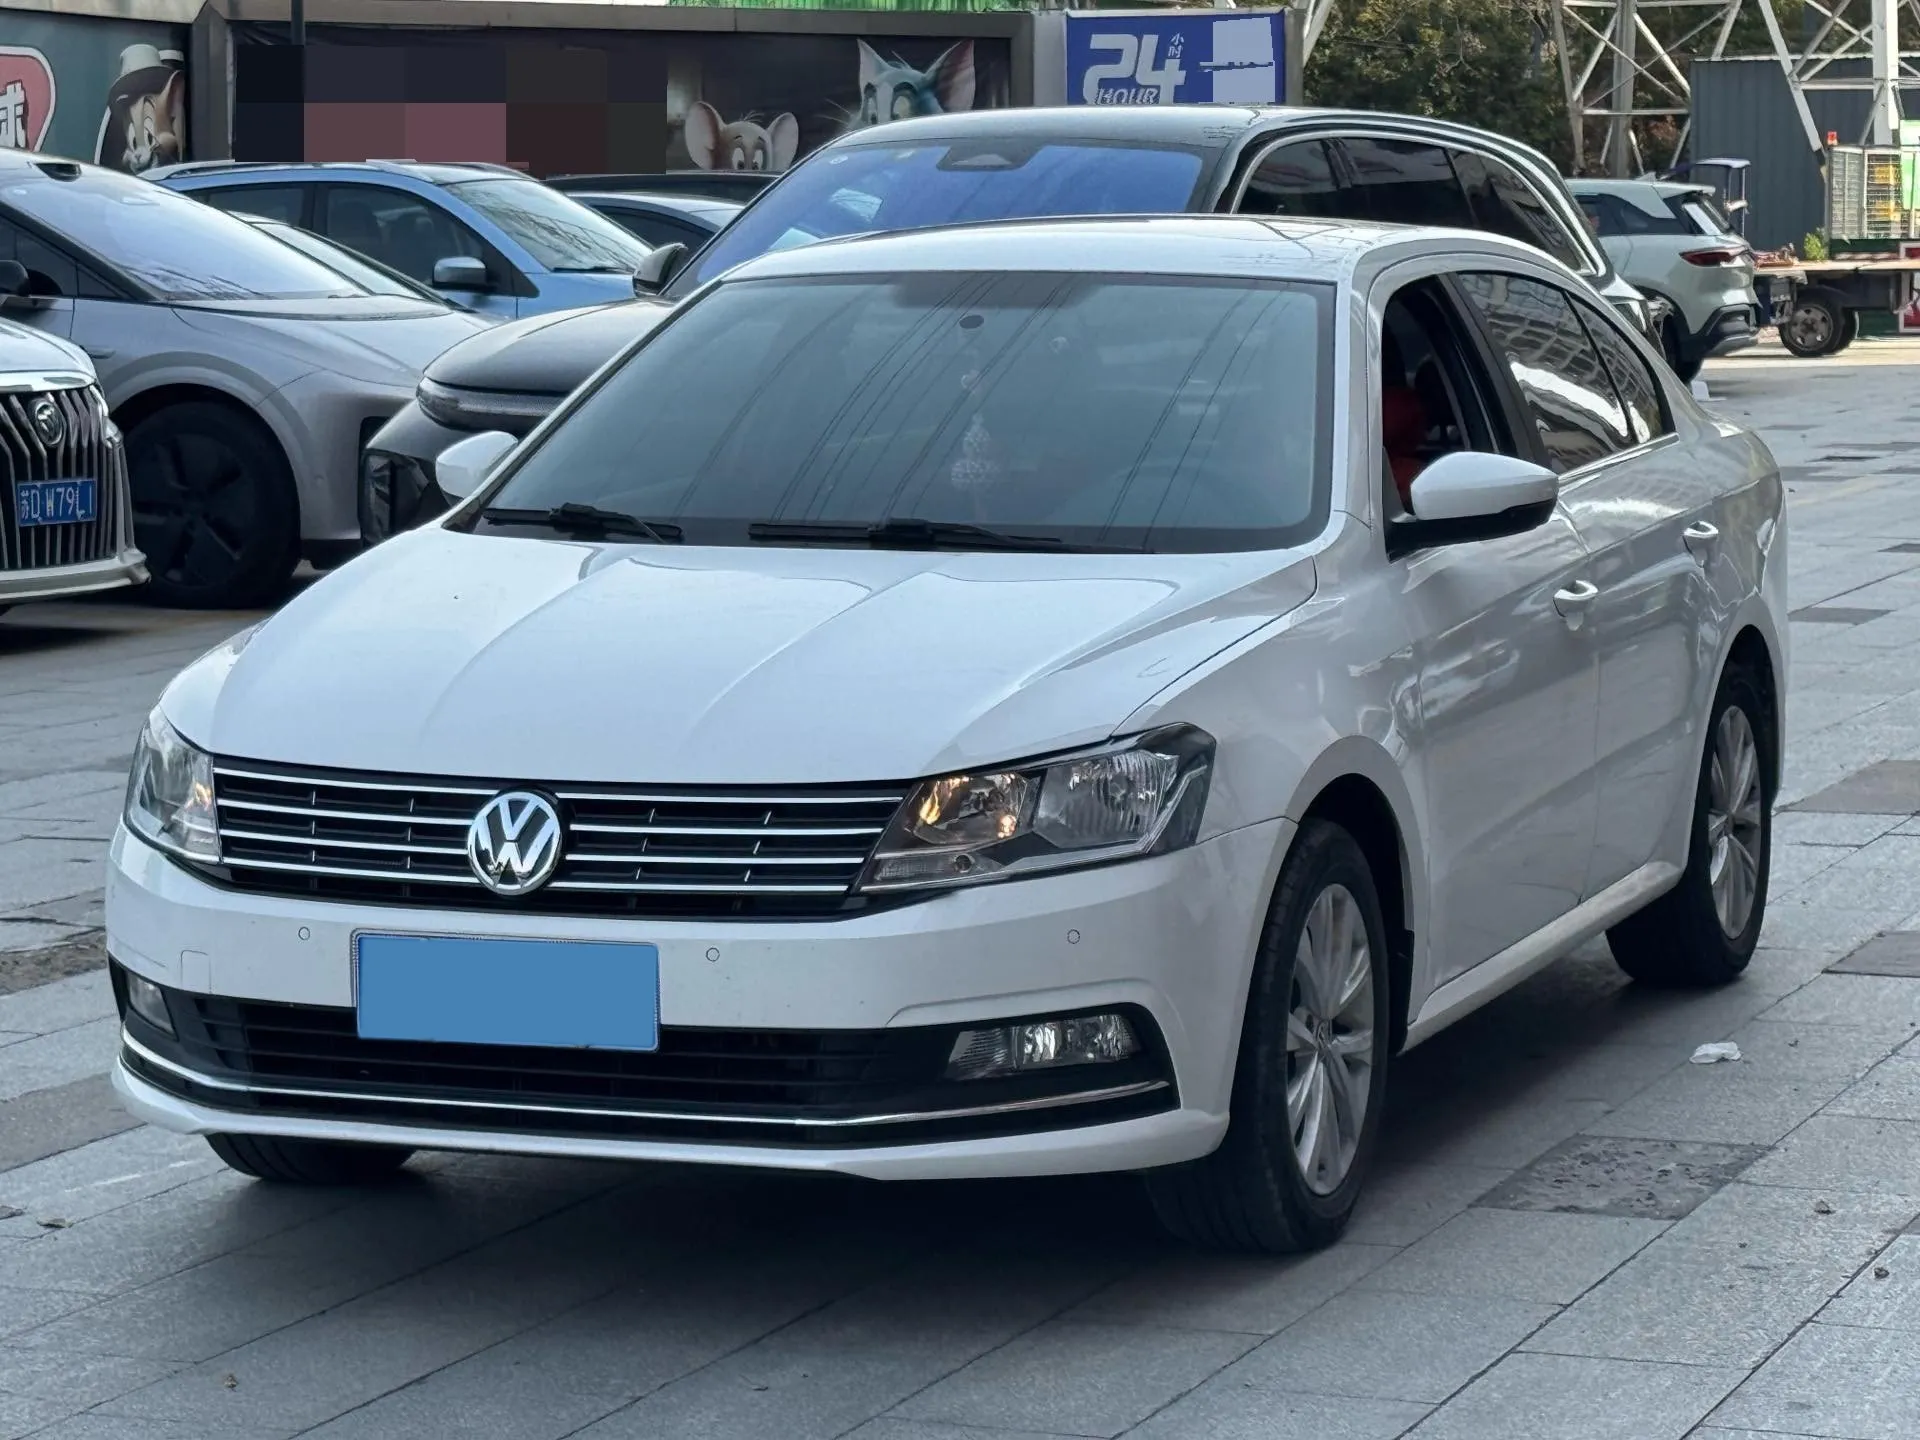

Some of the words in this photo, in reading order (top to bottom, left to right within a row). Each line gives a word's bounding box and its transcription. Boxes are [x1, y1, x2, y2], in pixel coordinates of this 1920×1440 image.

[1167, 32, 1185, 59] 小时
[1083, 34, 1187, 104] 24
[1097, 88, 1159, 105] HOUR
